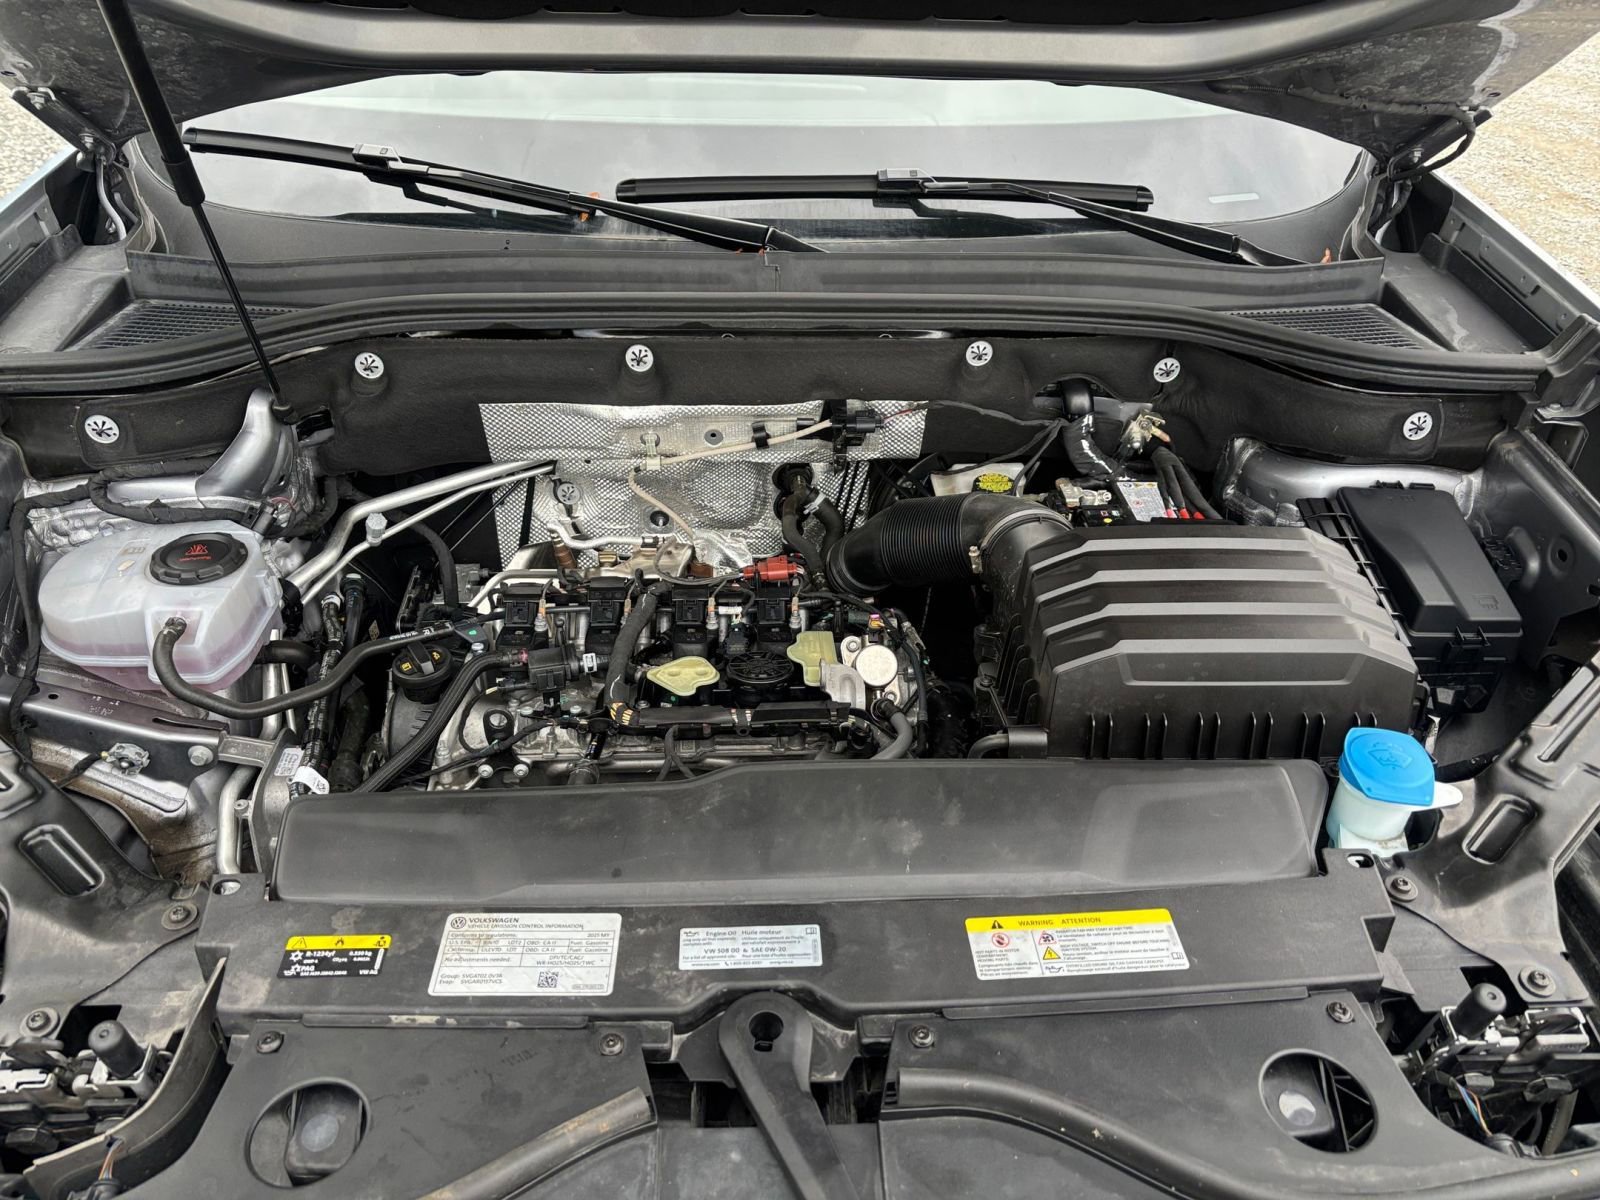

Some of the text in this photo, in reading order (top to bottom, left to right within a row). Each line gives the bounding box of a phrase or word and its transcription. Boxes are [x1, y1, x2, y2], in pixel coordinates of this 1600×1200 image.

[1017, 917, 1101, 927] WARNING ATTENTION
[705, 930, 727, 938] Engine
[759, 928, 781, 936] moteur
[305, 950, 336, 958] R-1234yf
